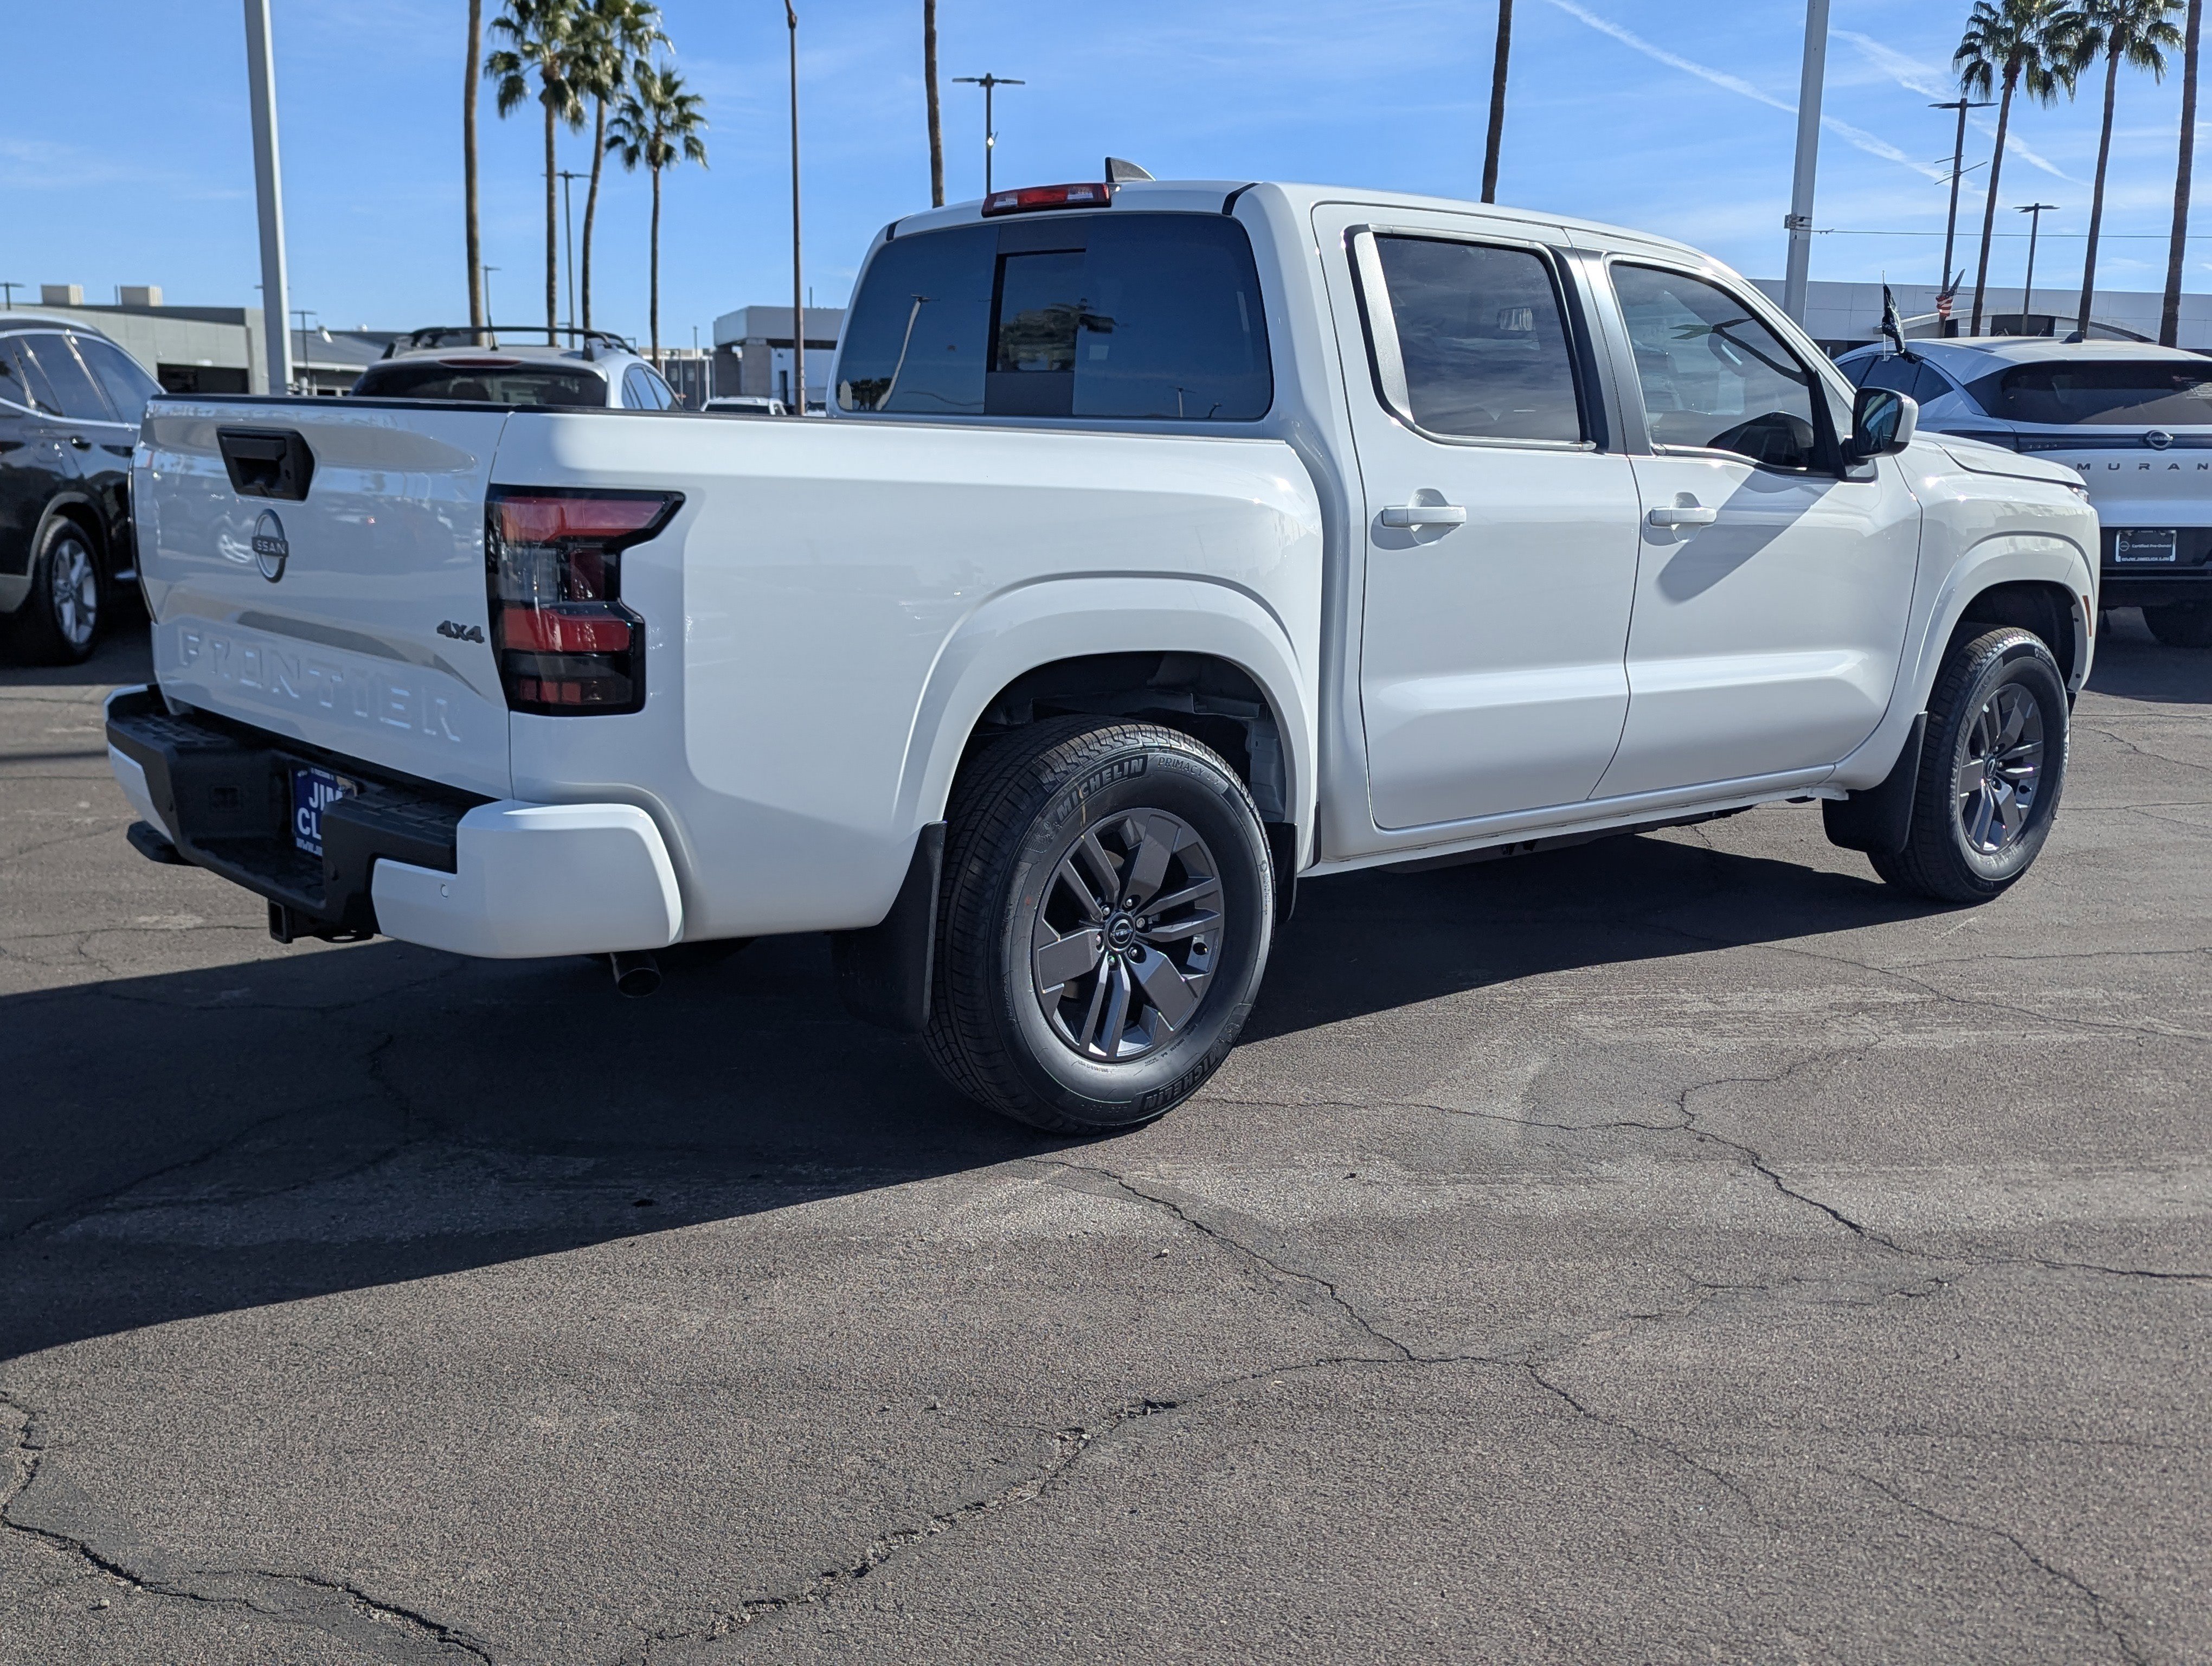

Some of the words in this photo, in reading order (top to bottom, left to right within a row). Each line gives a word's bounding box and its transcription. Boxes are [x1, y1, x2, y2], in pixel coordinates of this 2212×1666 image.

[2076, 463, 2209, 471] MURAN
[178, 626, 461, 742] FRONTIER
[1057, 758, 1143, 820] MICHELIN
[1158, 757, 1205, 778] PRIMACY
